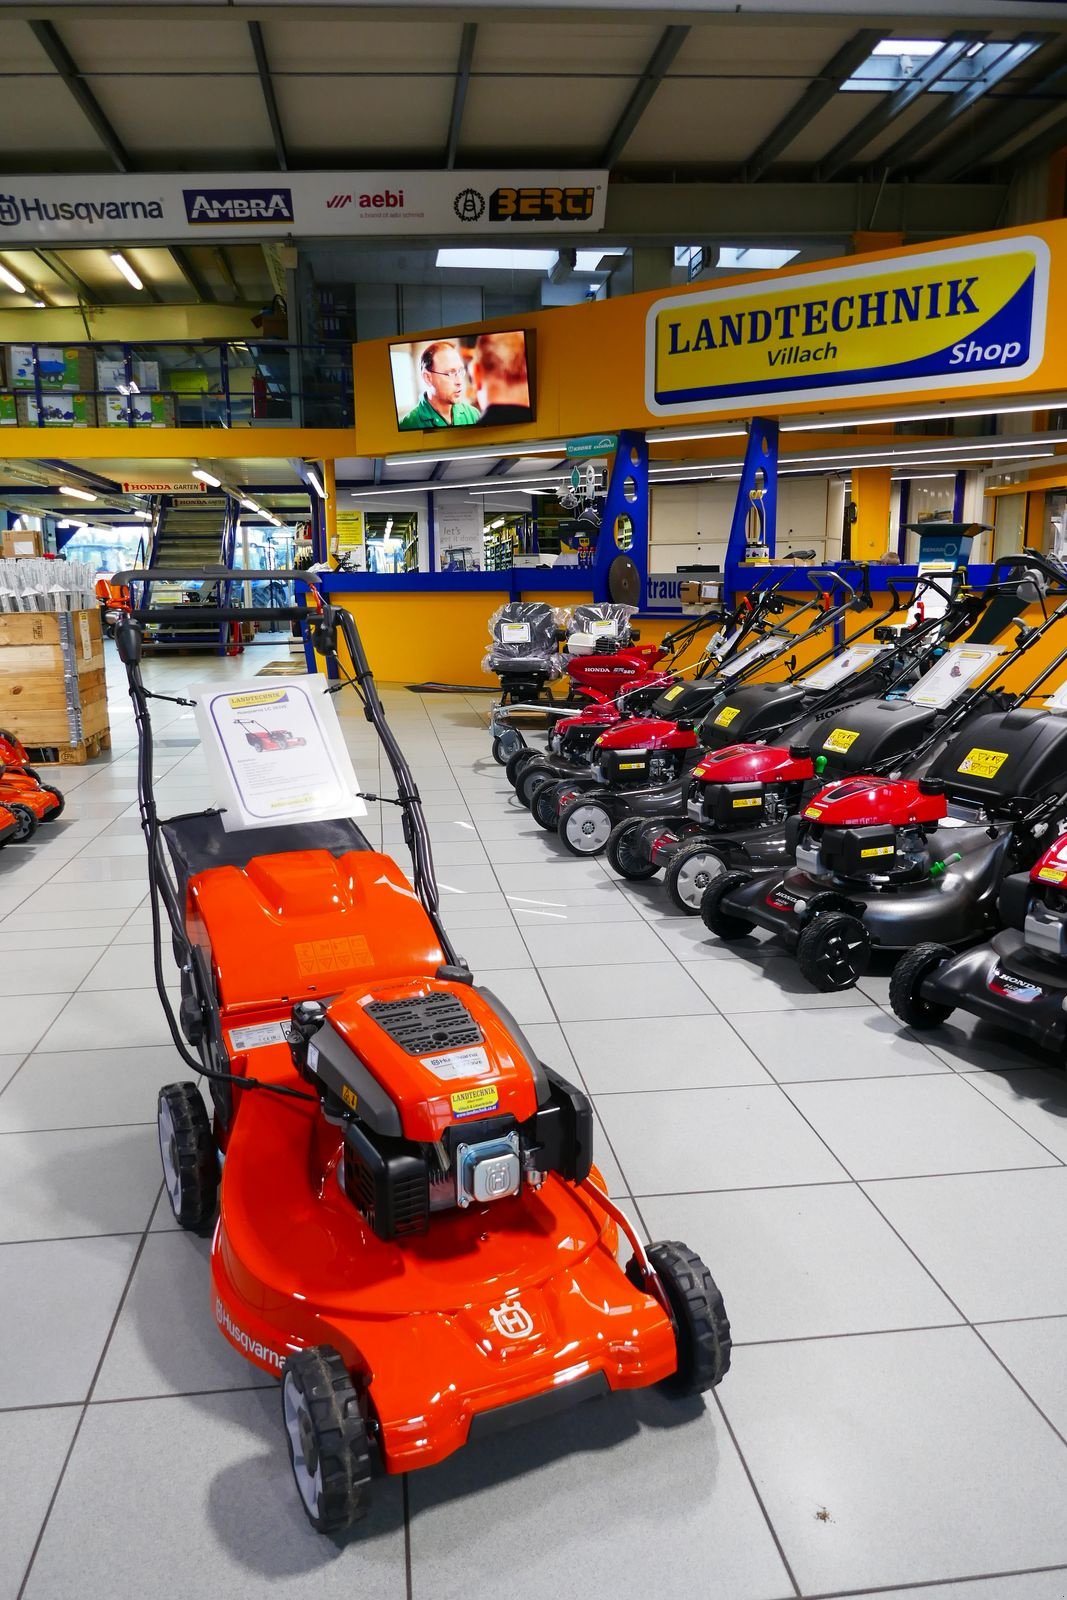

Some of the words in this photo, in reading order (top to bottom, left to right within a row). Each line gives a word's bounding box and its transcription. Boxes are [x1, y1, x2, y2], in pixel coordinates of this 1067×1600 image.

[191, 195, 290, 219] AMBRA
[359, 190, 404, 207] aebi
[20, 198, 164, 224] Husqvarna
[668, 277, 979, 355] LANDTECHNIK
[768, 342, 837, 366] Villach
[949, 341, 1021, 364] Shop
[999, 973, 1042, 994] HONDA
[452, 1087, 496, 1102] LANDTECHNIK
[223, 1310, 286, 1369] Husqvarna
